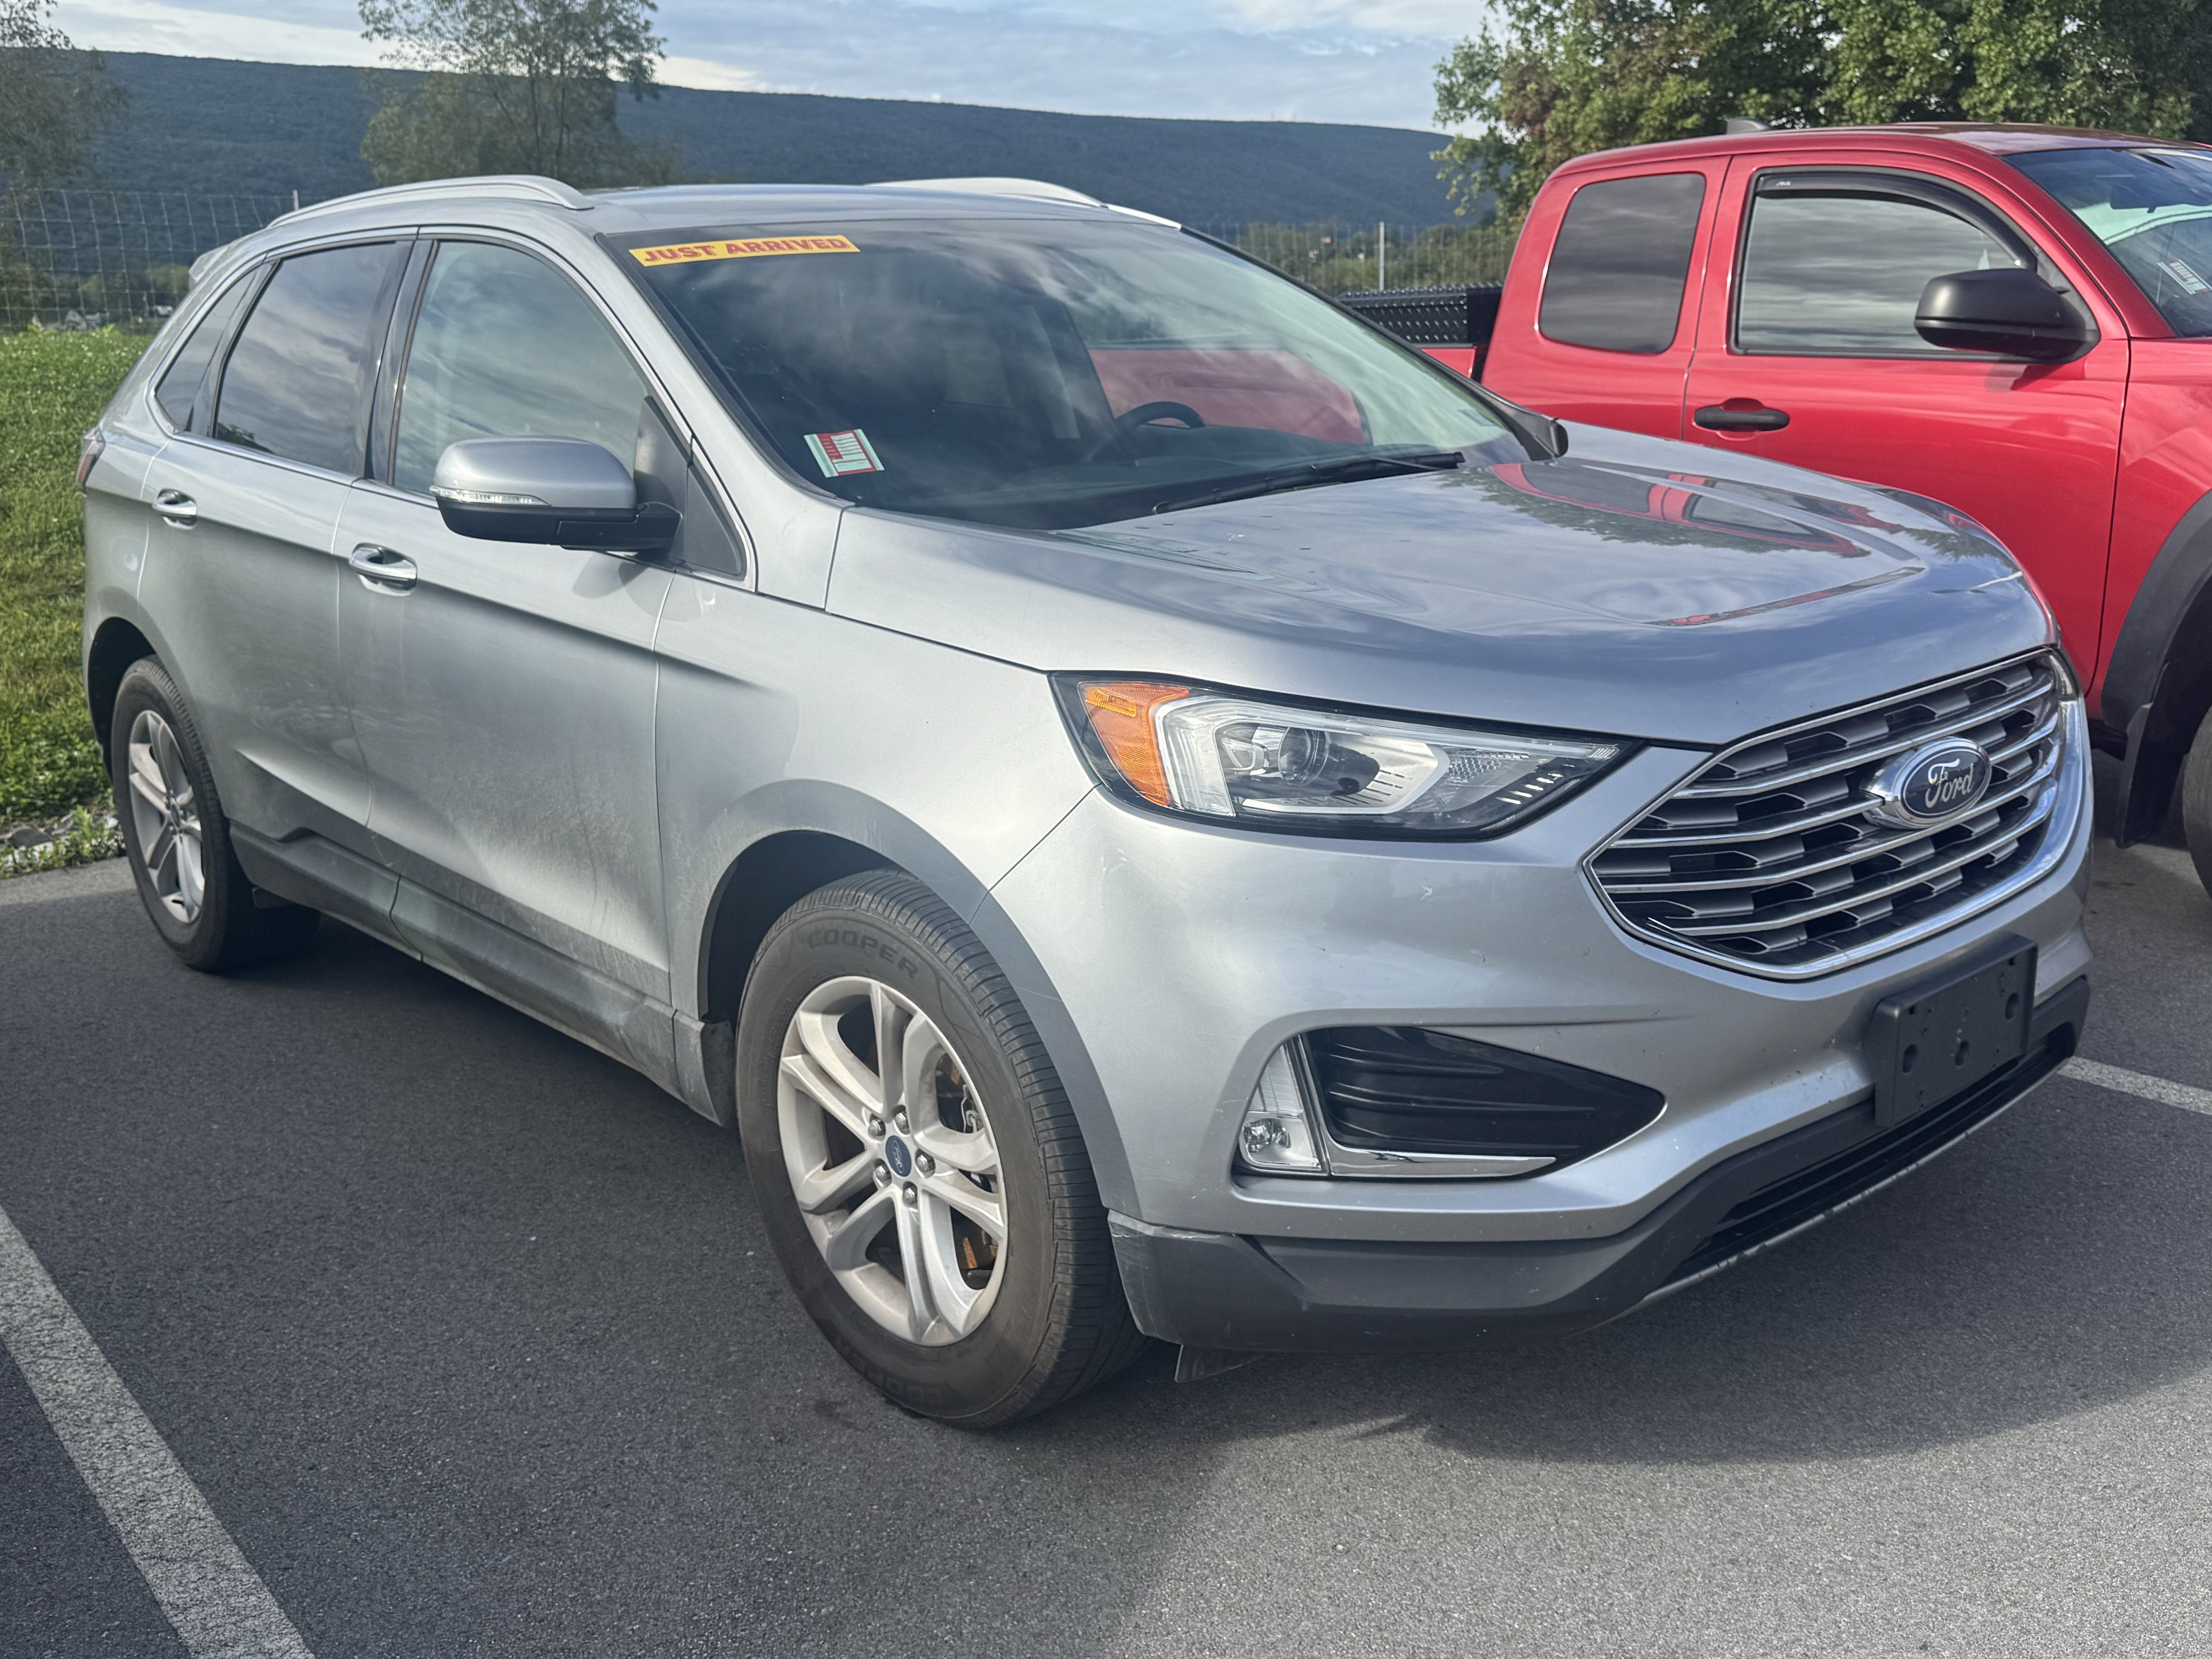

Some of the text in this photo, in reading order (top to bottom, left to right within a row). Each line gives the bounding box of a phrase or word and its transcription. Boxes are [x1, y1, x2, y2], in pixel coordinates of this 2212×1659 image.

[645, 239, 850, 263] JUST ARRIVED
[1925, 758, 1974, 808] Ford
[808, 929, 919, 980] COOPER
